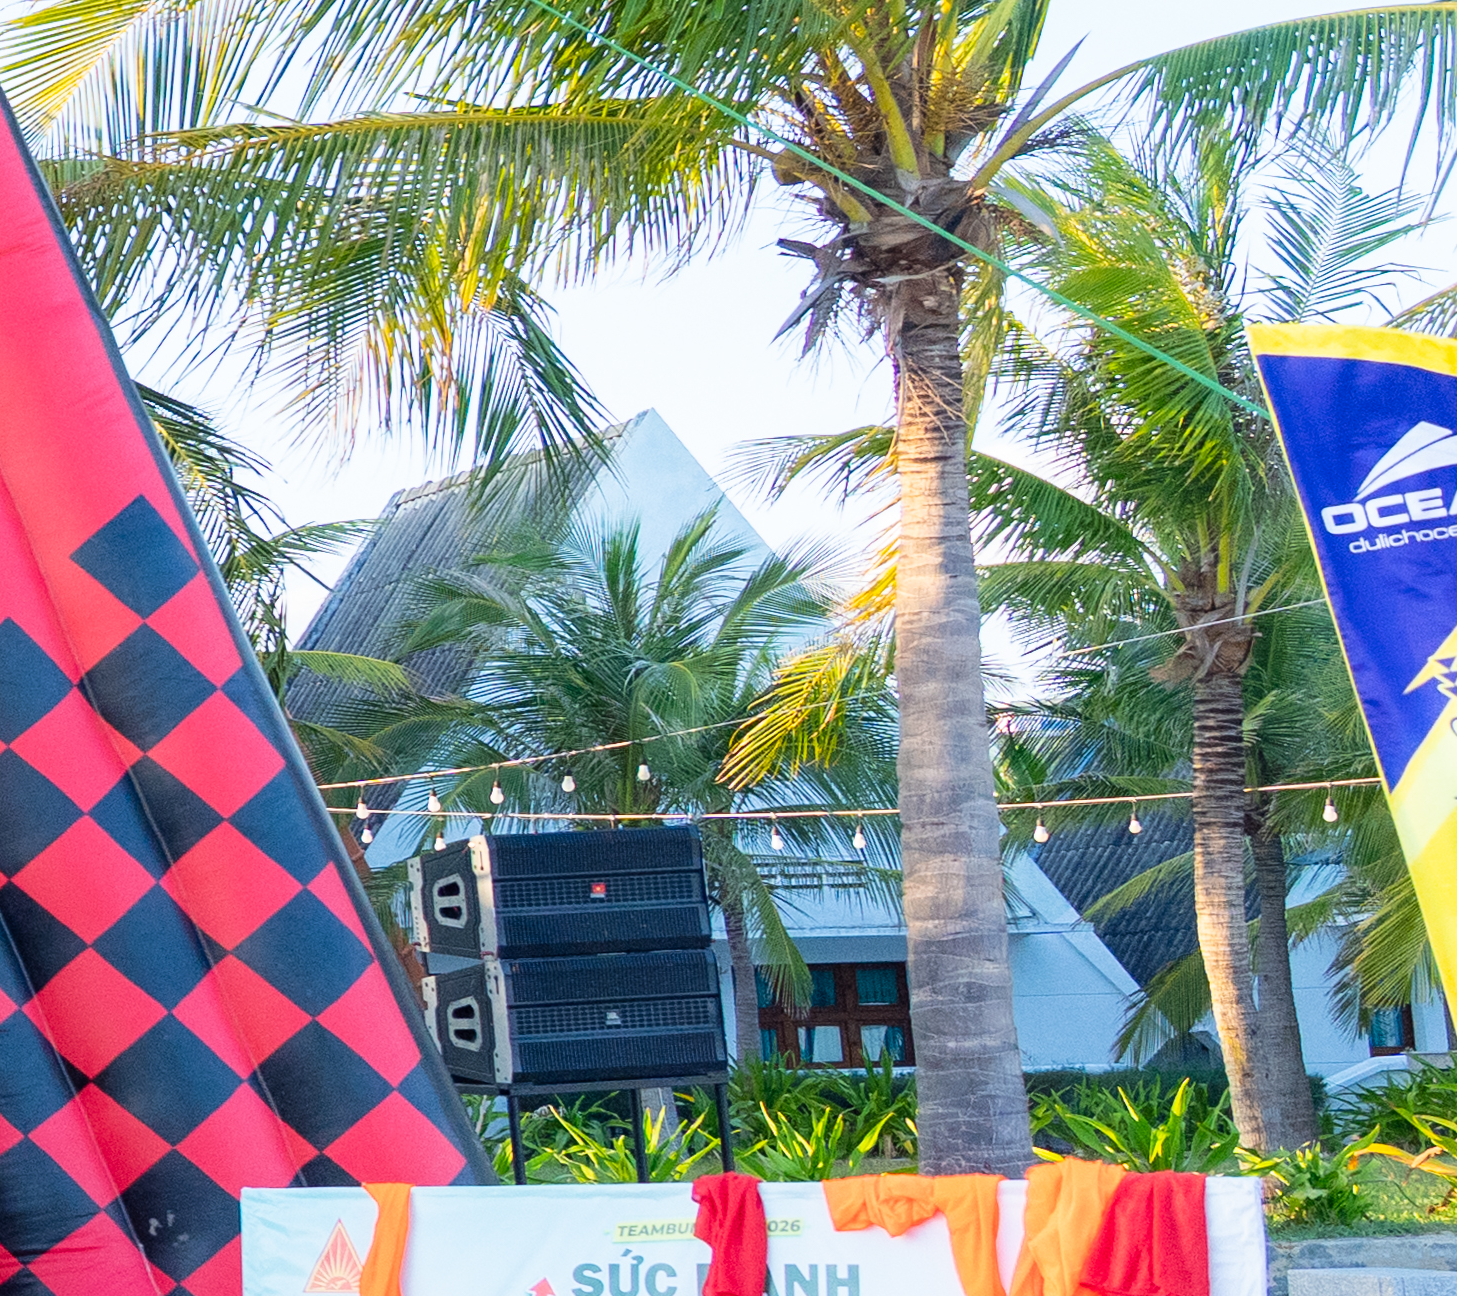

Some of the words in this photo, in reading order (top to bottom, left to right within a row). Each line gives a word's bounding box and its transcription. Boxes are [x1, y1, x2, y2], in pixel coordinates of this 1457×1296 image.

[1322, 488, 1457, 534] OCE
[618, 1222, 695, 1236] TEAMBUI
[768, 1220, 801, 1232] 026
